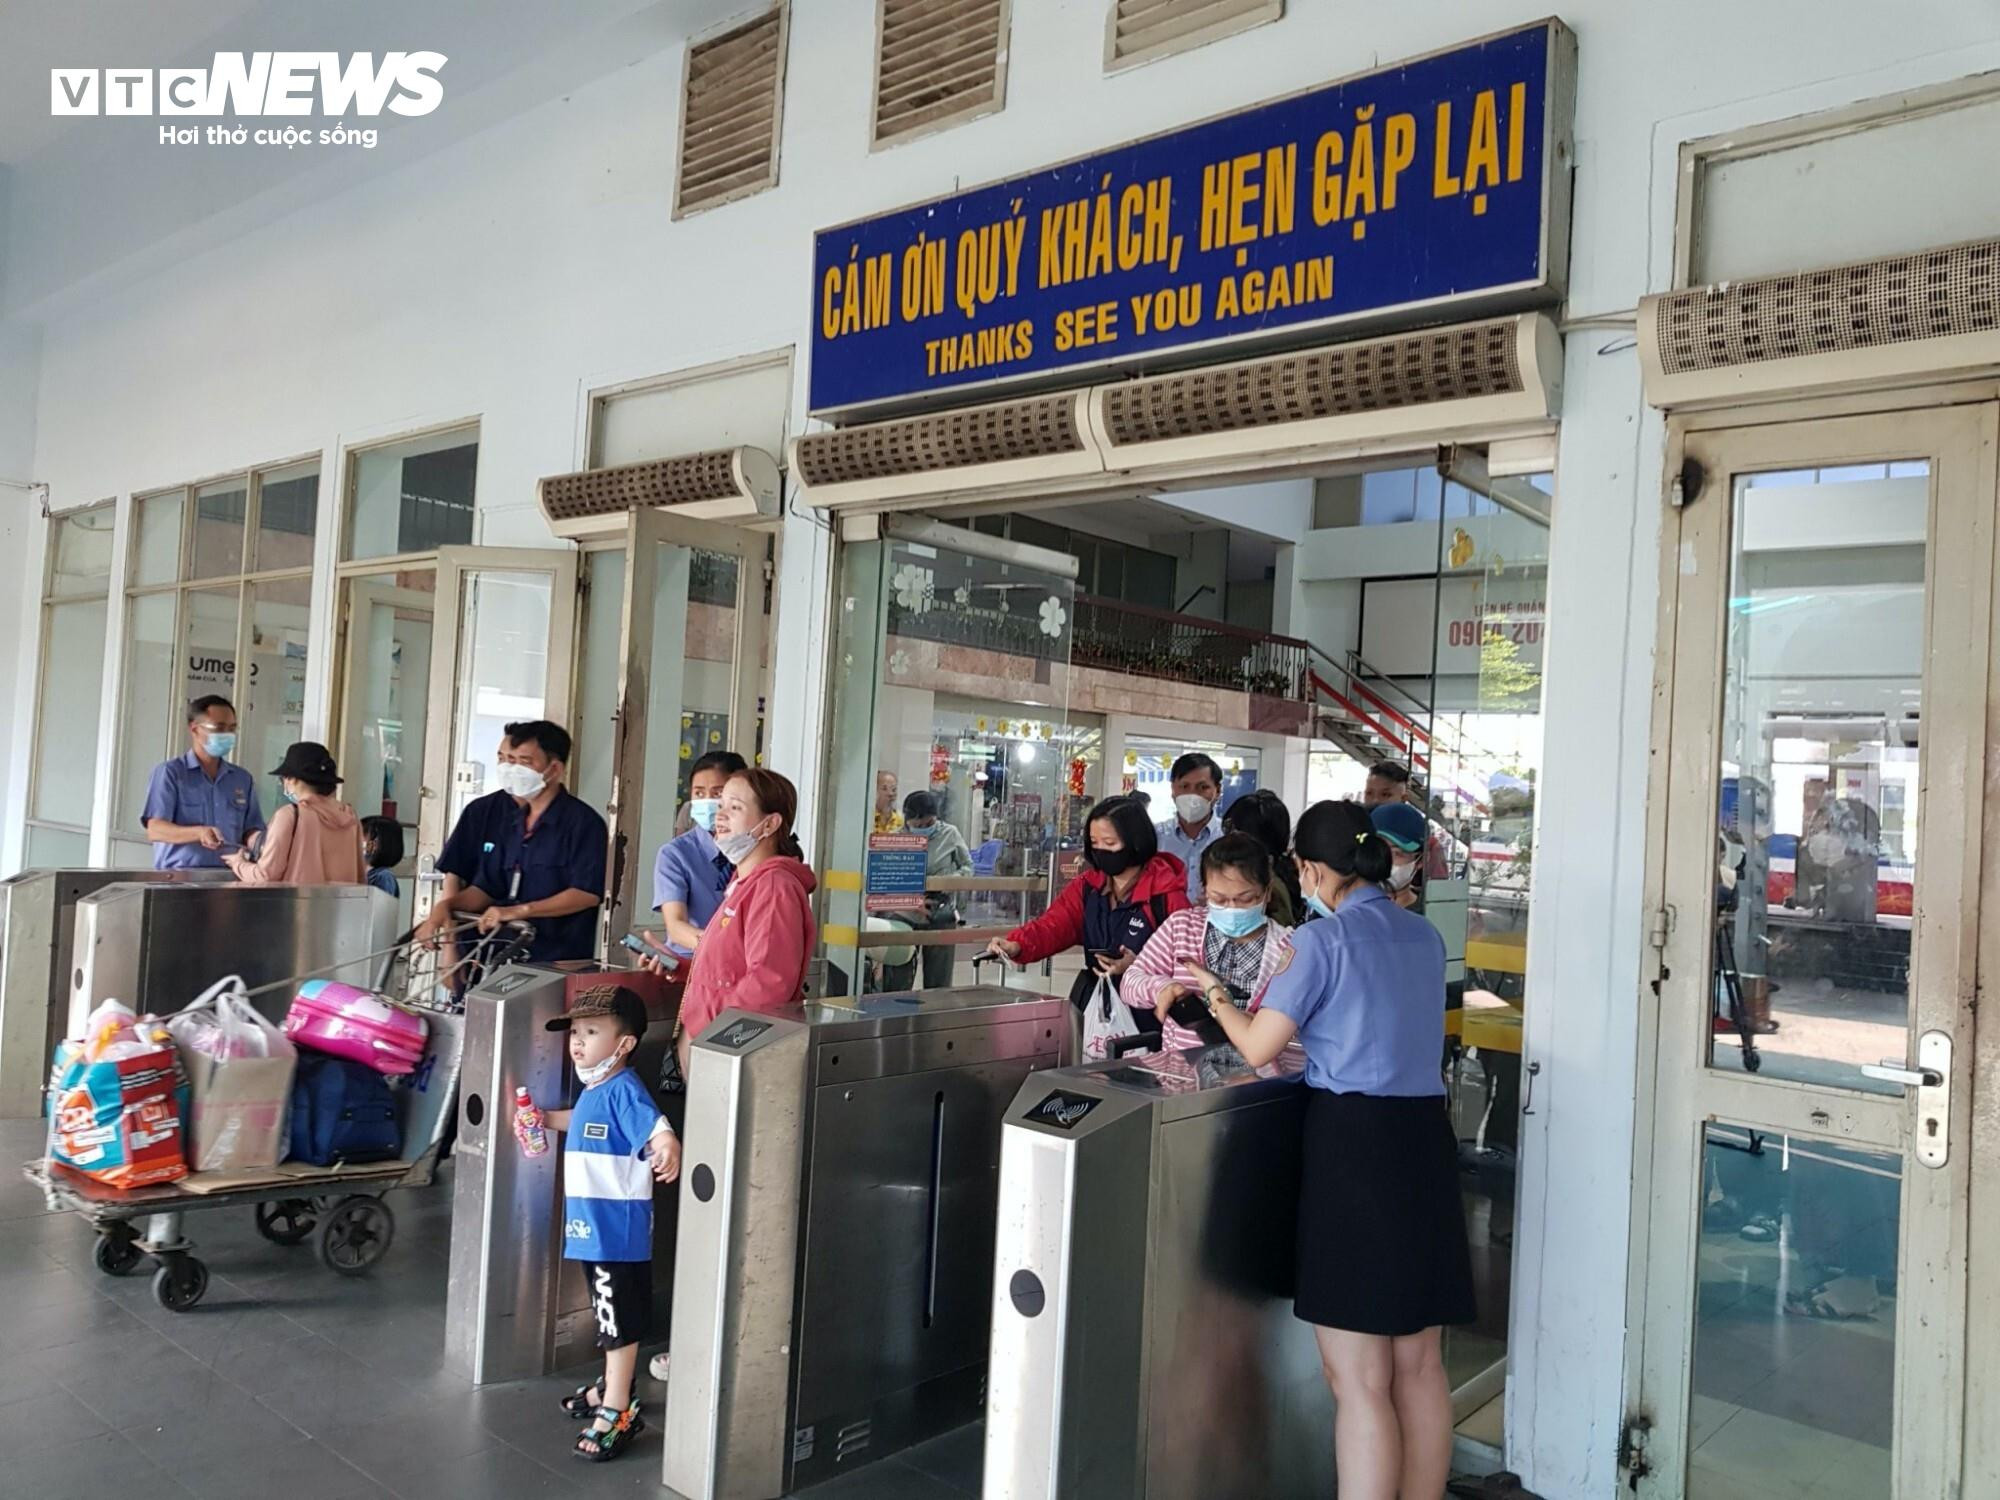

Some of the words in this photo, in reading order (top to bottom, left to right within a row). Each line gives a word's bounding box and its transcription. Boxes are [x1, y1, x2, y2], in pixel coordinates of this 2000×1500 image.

[822, 244, 892, 340] CÁM
[901, 231, 947, 322] ƠN
[956, 197, 1027, 319] QUÝ
[1039, 172, 1184, 289] KHÁCH,
[1200, 142, 1298, 267] HẸN
[1312, 103, 1417, 241] GẶP
[1433, 82, 1526, 216] LẠI
[925, 319, 1034, 377] THANKS
[1055, 301, 1119, 352] SEE
[1130, 283, 1203, 336] YOU
[1215, 255, 1335, 320] AGAIN
